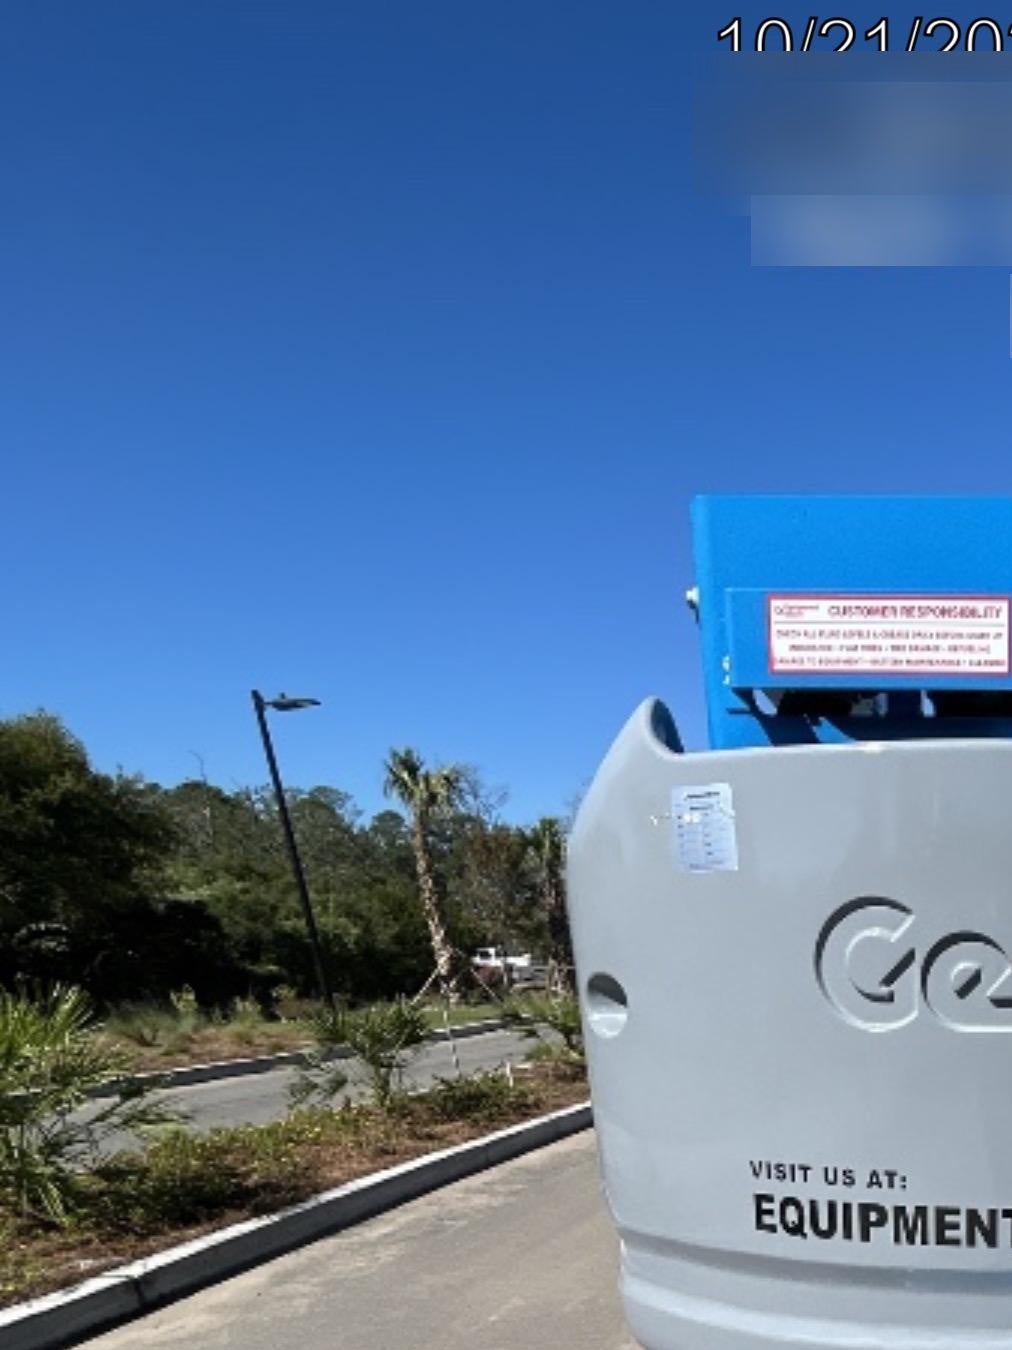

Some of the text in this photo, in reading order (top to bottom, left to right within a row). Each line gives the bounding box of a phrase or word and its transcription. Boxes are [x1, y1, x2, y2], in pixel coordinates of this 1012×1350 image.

[749, 1160, 907, 1190] VISIT US AT:
